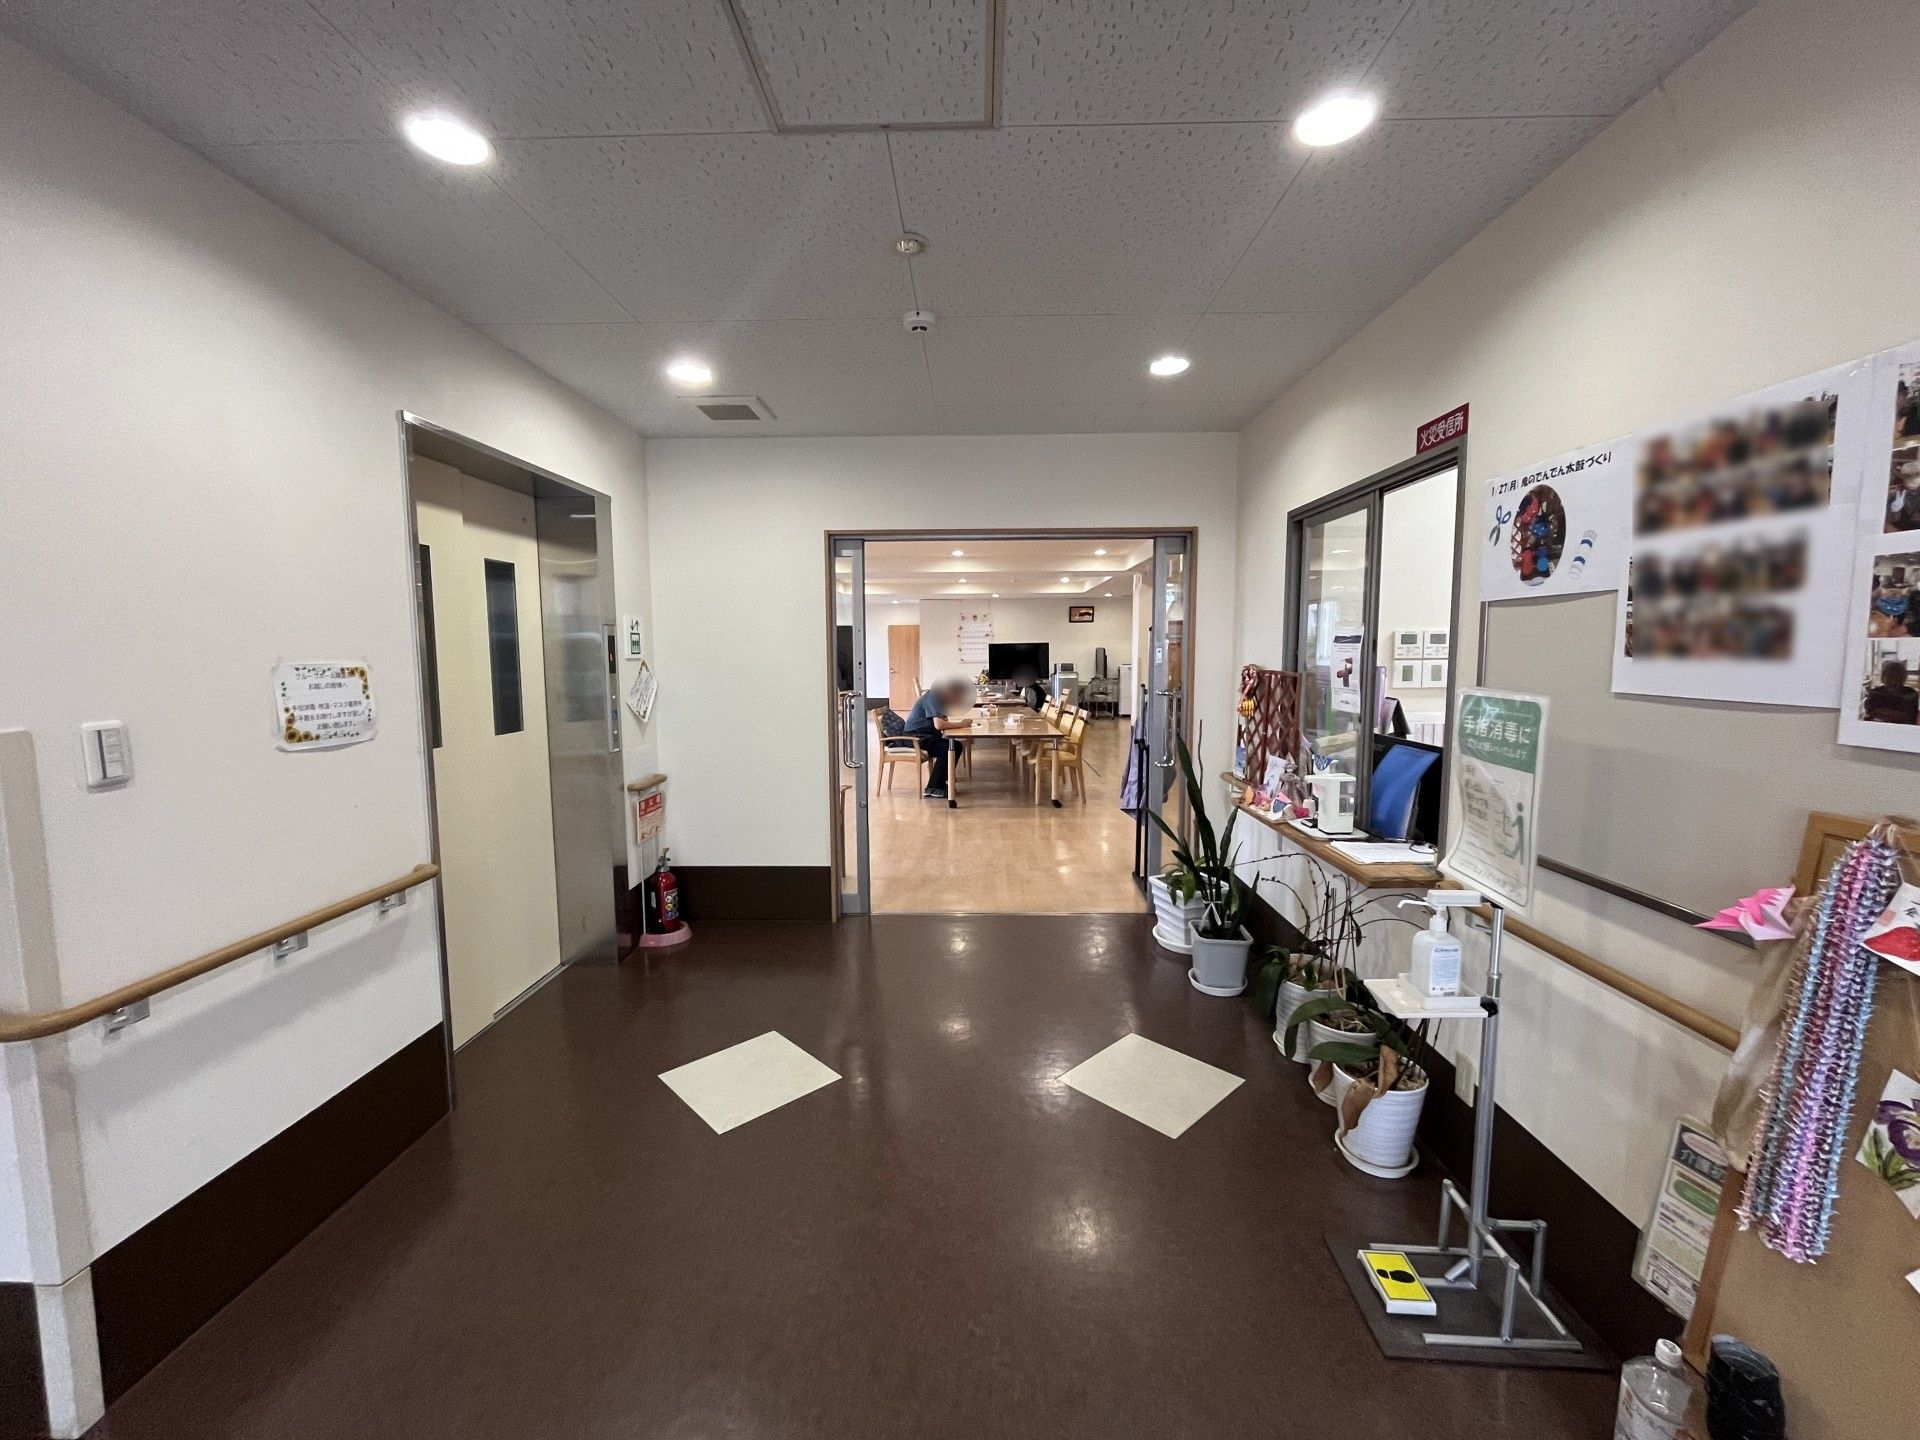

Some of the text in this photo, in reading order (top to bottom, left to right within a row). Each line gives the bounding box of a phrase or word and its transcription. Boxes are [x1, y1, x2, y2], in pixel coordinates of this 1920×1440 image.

[1520, 451, 1612, 488] 鬼のでんでん太鼓づくり
[1463, 715, 1532, 744] 手指消毒に
